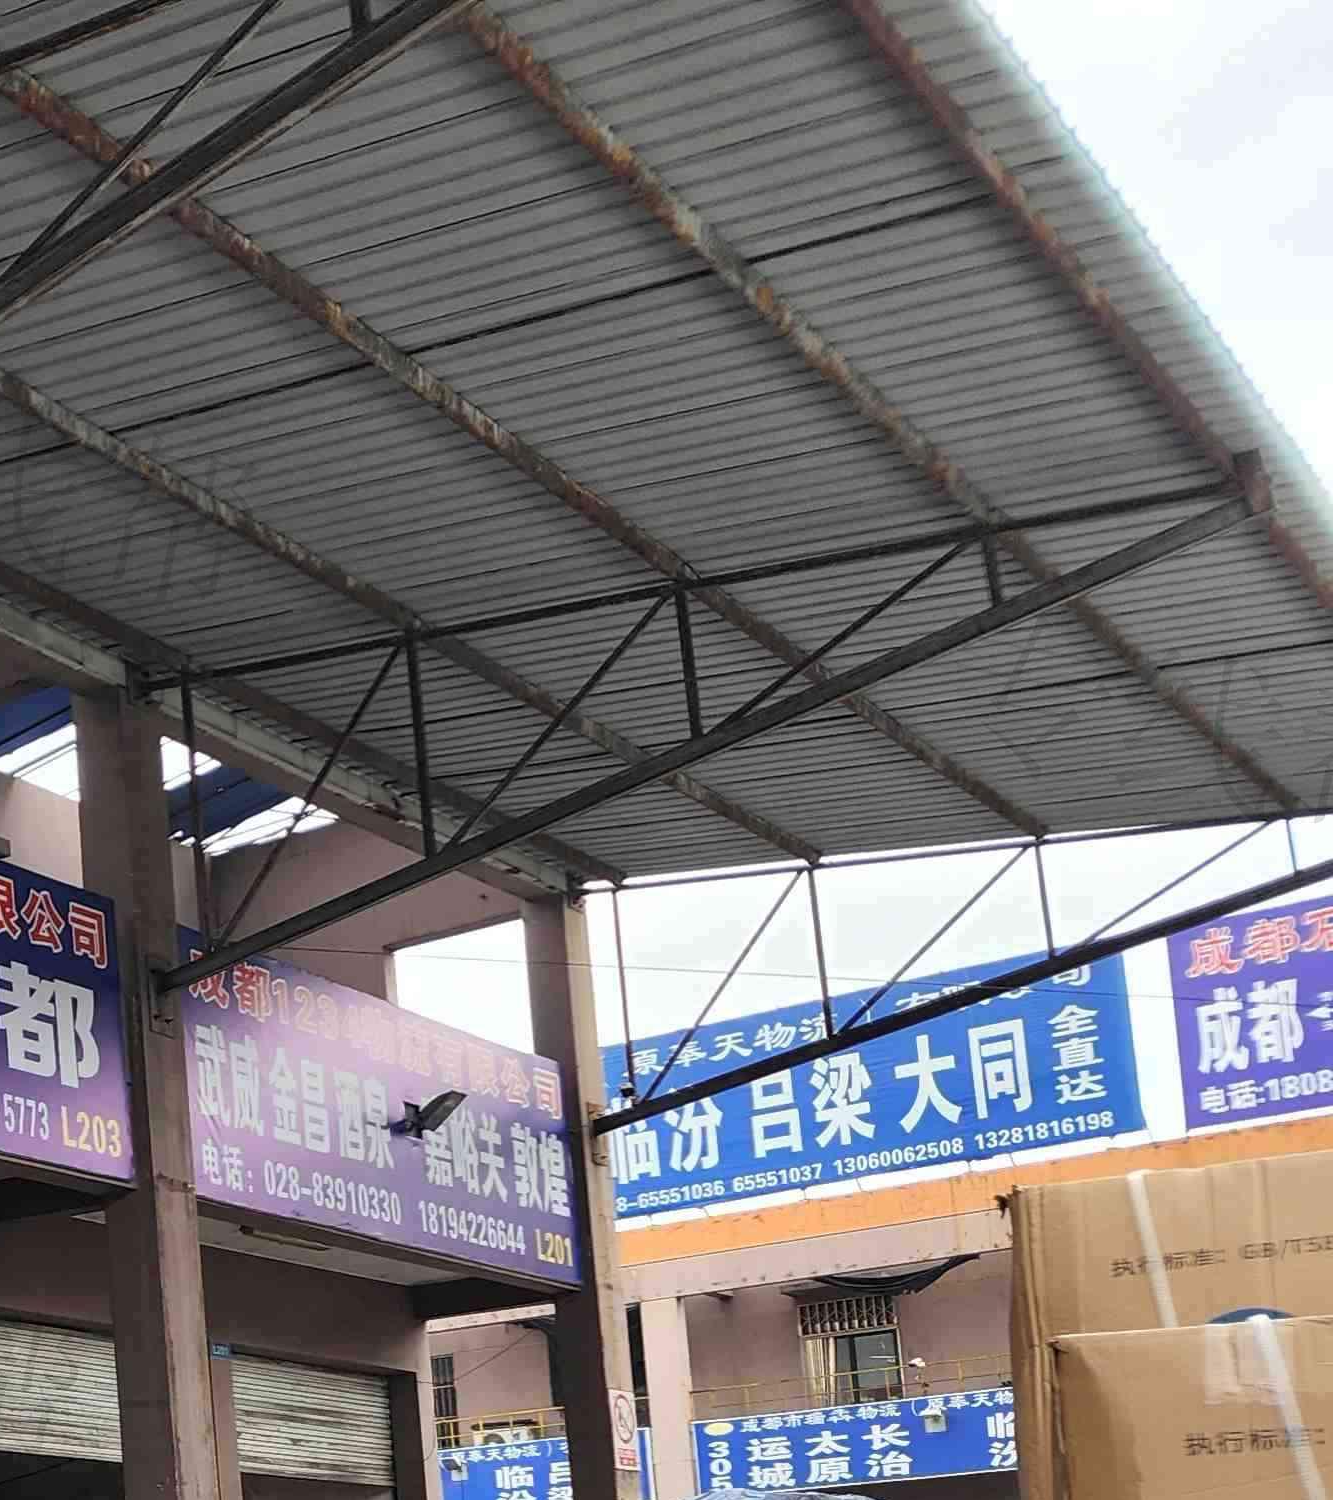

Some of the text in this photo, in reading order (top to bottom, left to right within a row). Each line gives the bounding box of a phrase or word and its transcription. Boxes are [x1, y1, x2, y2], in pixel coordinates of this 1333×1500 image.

[1046, 1003, 1109, 1106] 全直达
[1194, 977, 1305, 1076] 成都
[60, 1106, 122, 1158] L203
[268, 1048, 332, 1154] 金昌
[335, 1069, 396, 1170] 酒泉
[509, 1121, 572, 1219] 敦煌
[749, 1050, 878, 1161] 吕梁
[893, 1017, 1035, 1134] 大同
[732, 1162, 824, 1195] 65551037
[831, 1136, 966, 1177] 13060062508
[972, 1108, 1116, 1151] 13281816198
[263, 1159, 404, 1227] 028-83910330
[417, 1200, 527, 1256] 18194226644
[534, 1228, 575, 1269] L201
